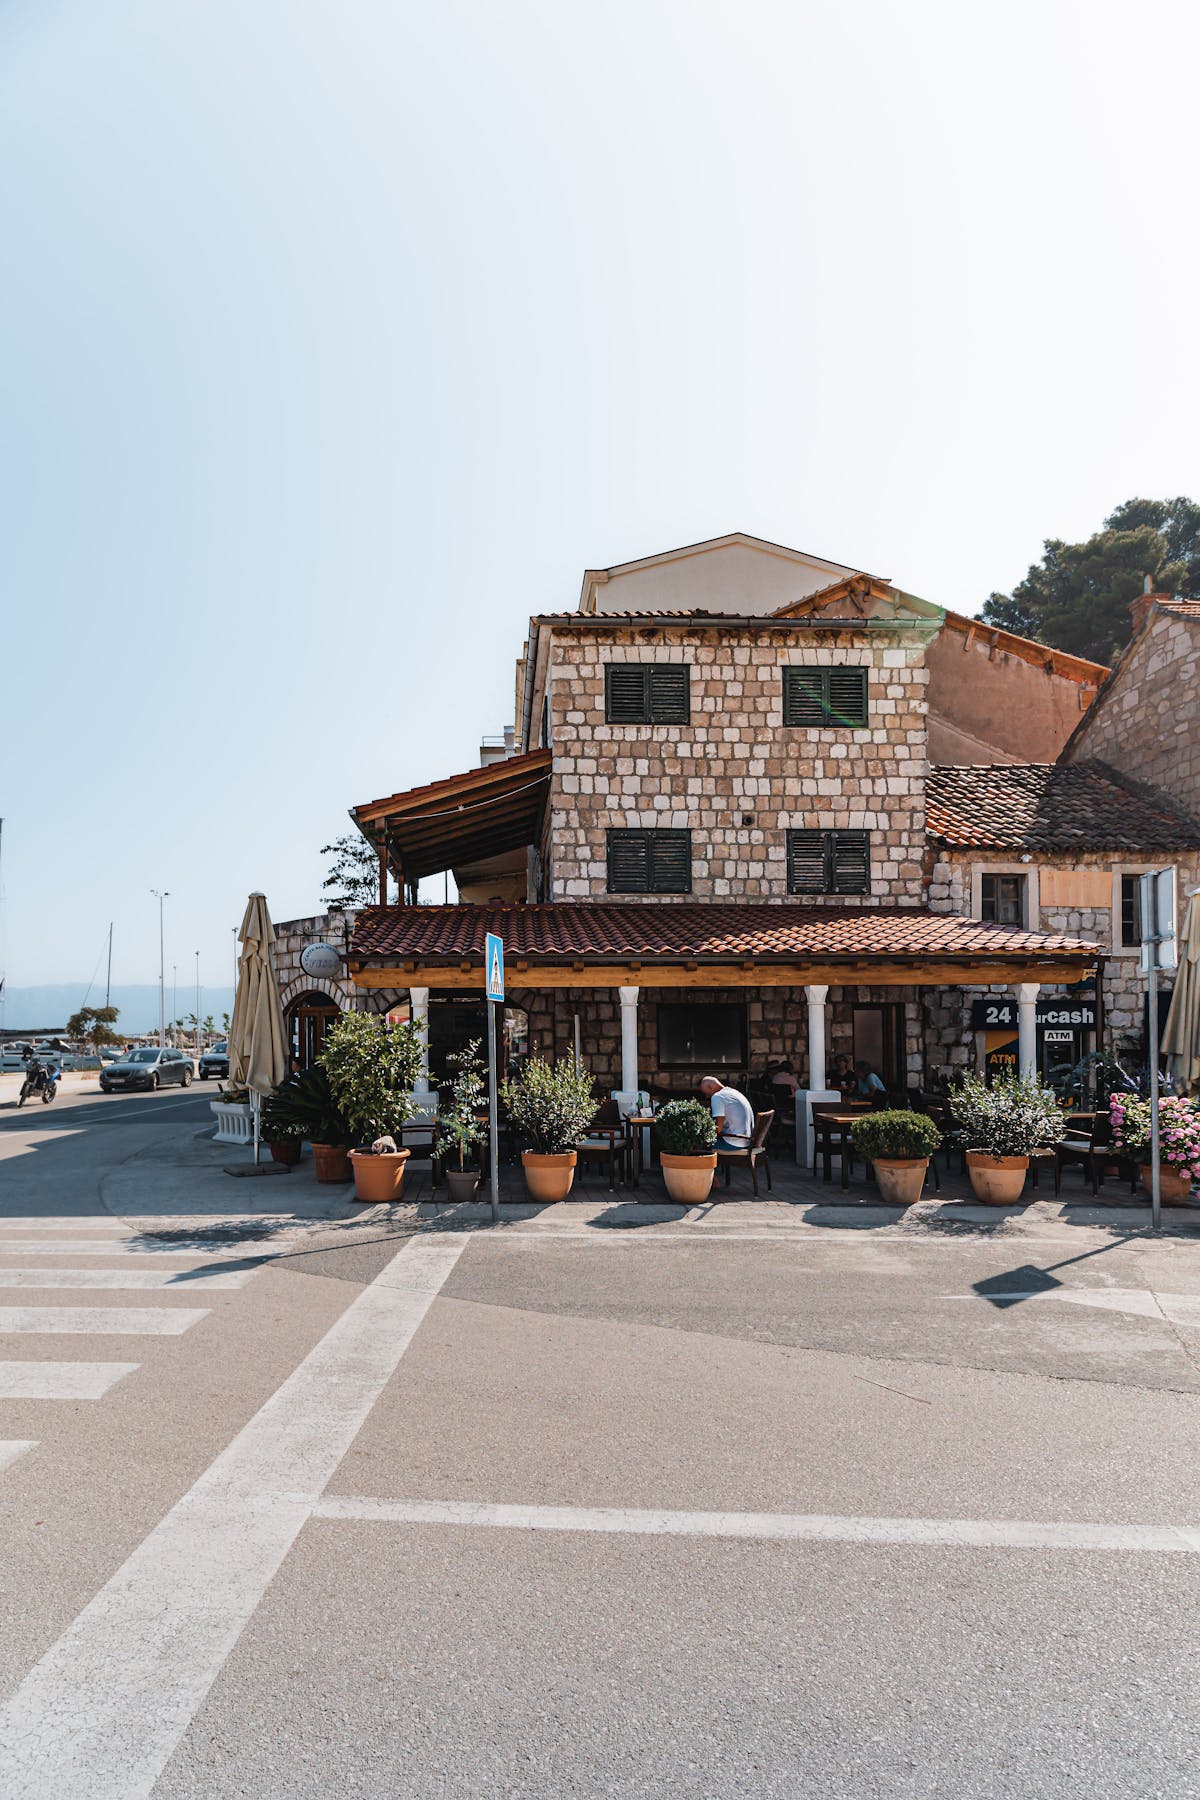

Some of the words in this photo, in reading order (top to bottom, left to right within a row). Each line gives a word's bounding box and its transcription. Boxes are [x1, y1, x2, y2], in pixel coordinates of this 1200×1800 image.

[986, 1007, 1011, 1023] 24
[1016, 1008, 1094, 1024] urcash
[1047, 1032, 1070, 1040] ATM
[990, 1054, 1016, 1064] ATM
